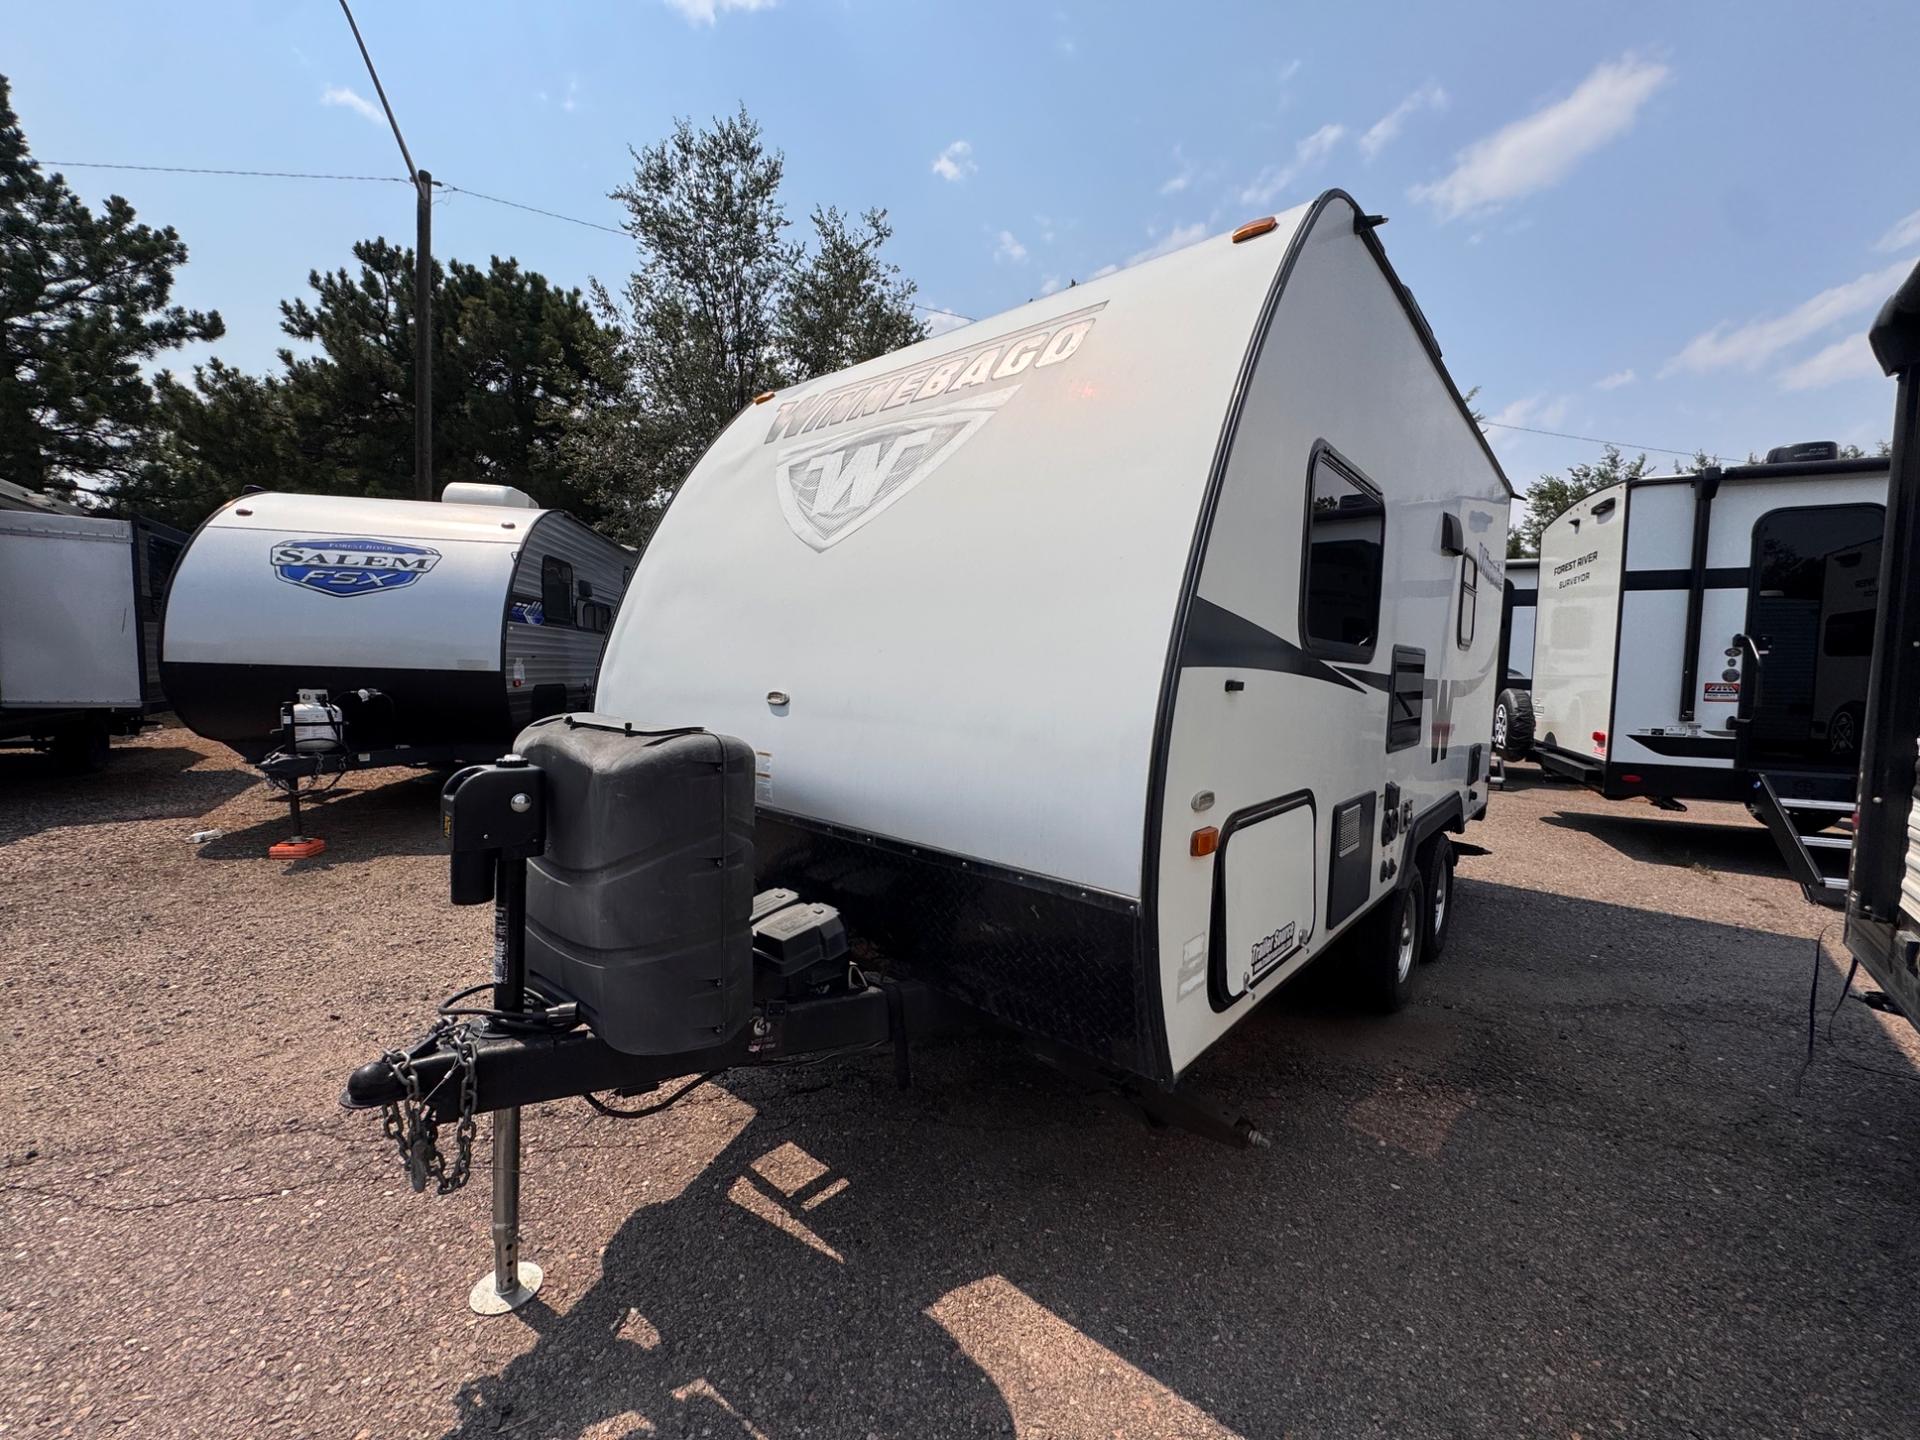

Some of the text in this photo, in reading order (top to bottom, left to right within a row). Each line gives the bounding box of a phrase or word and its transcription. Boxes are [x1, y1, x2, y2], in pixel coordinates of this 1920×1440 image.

[764, 318, 1096, 444] WINNEBAGO
[806, 427, 937, 515] W
[276, 549, 429, 569] SALEM
[1553, 551, 1598, 576] FOREST RIVER
[300, 570, 397, 587] FSX
[1558, 571, 1590, 590] SURVEYOR
